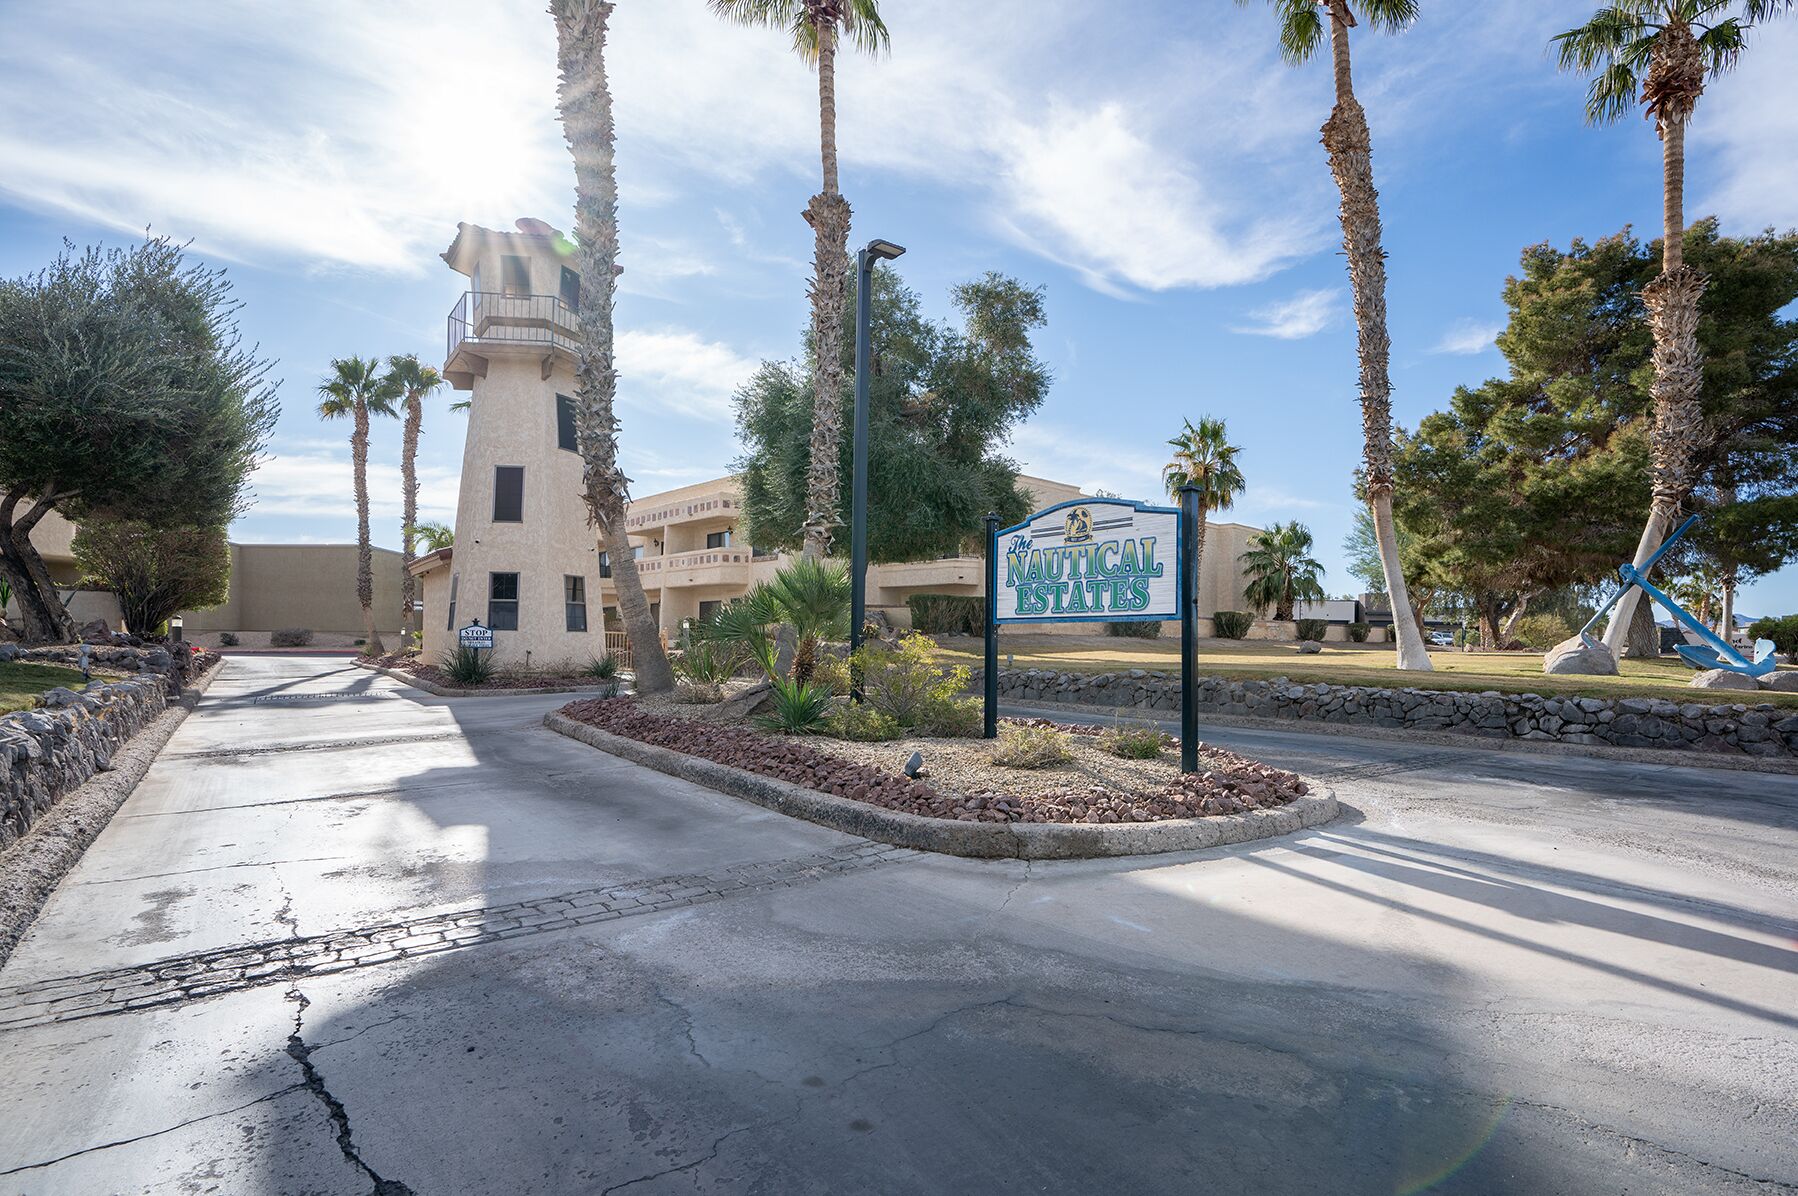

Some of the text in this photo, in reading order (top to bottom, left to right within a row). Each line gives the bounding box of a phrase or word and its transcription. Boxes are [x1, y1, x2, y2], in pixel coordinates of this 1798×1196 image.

[1006, 536, 1163, 587] NAUTICAL
[1009, 535, 1033, 552] The
[1015, 577, 1150, 615] ESTATES
